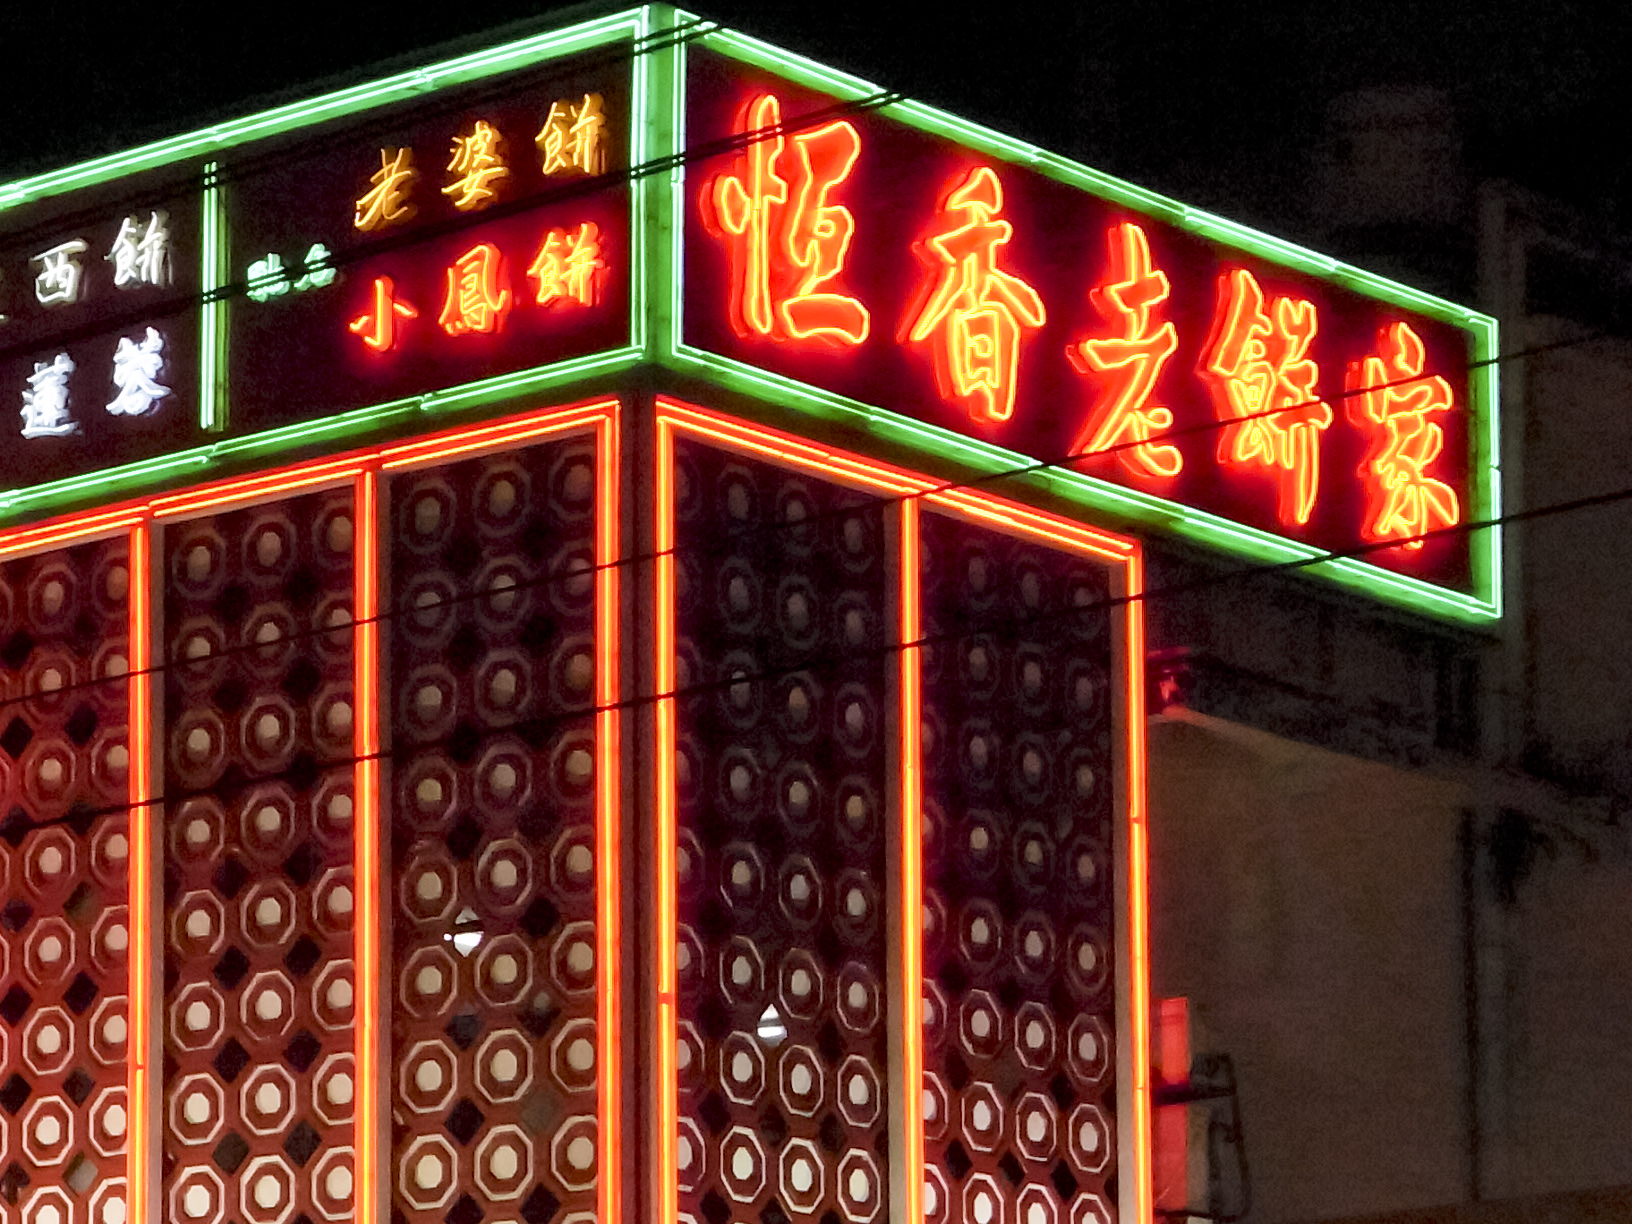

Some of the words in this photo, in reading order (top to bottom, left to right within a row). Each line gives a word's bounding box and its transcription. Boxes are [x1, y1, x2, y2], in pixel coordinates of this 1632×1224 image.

[355, 94, 606, 231] 老婆餅
[349, 222, 608, 352] 小鳳餅
